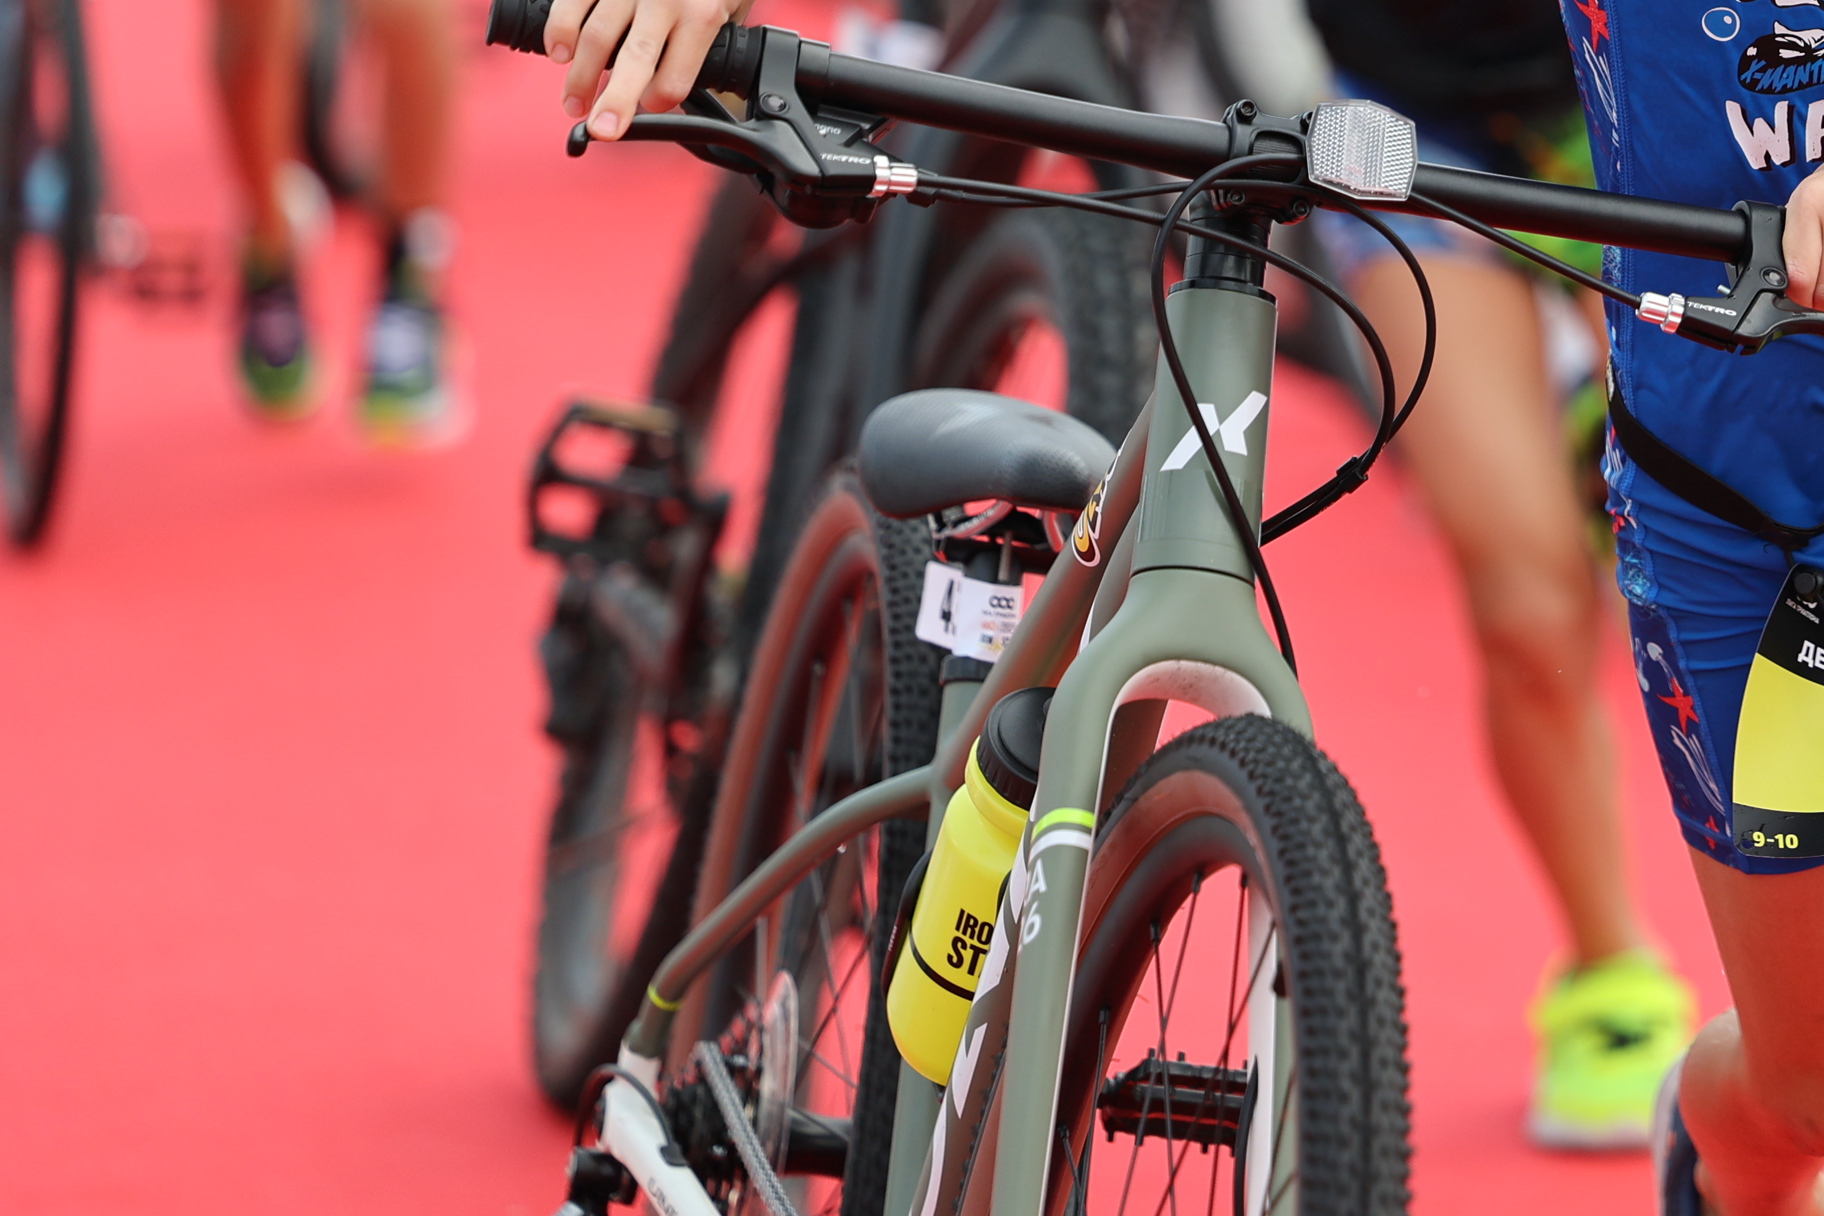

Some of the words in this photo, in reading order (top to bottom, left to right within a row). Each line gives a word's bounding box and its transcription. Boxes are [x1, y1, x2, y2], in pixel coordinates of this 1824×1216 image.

[820, 152, 872, 165] TEKTRO
[1687, 300, 1737, 316] TEKTRO
[1751, 831, 1800, 850] 9-10
[955, 908, 994, 945] IRO
[946, 936, 988, 978] ST
